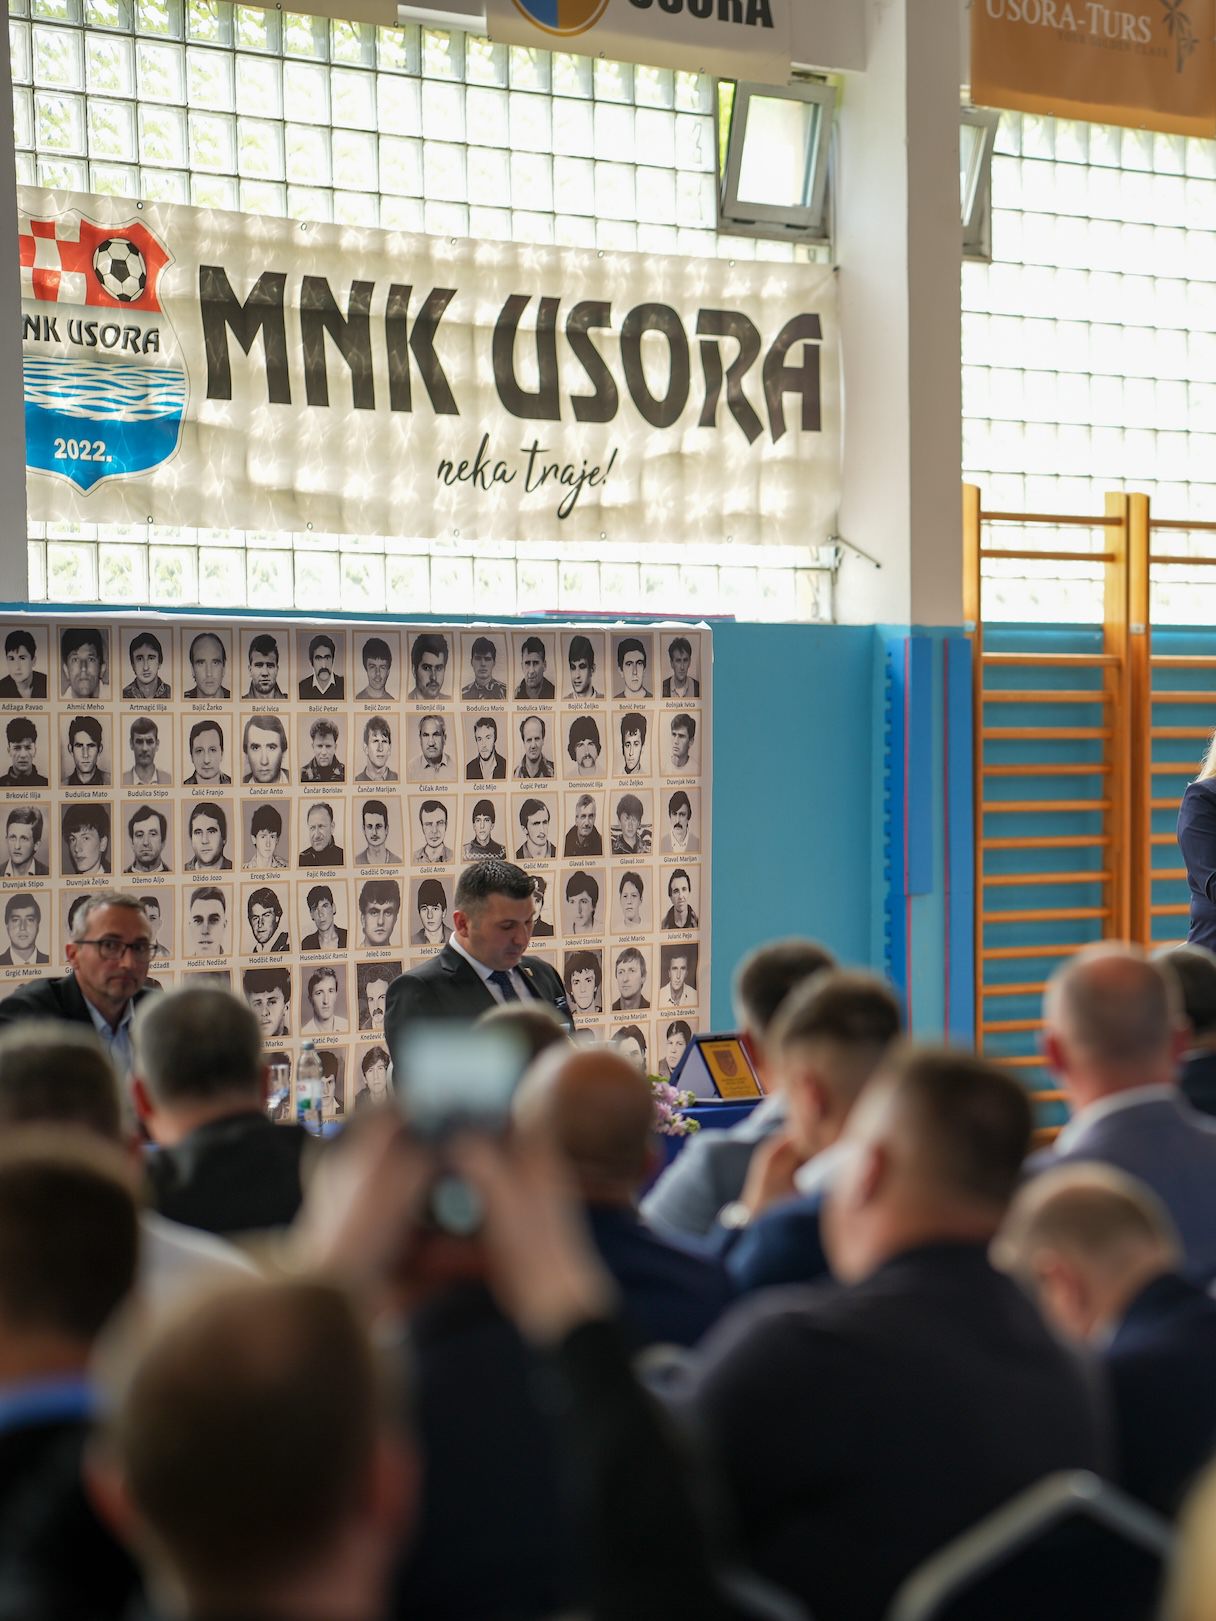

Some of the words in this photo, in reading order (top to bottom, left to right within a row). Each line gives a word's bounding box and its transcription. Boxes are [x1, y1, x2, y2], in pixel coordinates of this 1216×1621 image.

[986, 0, 1153, 43] USORA-TURS
[67, 319, 160, 354] USORA
[200, 265, 460, 415] MNK
[493, 294, 823, 445] USORA
[54, 438, 112, 462] 2022.
[437, 433, 518, 489] neka
[520, 440, 619, 520] traje!
[206, 703, 222, 711] Žarko
[364, 704, 376, 712] Bejić
[583, 702, 599, 710] Željko
[2, 881, 27, 889] Duvnjak
[66, 879, 90, 887] Duvnjak
[91, 878, 109, 886] Željko
